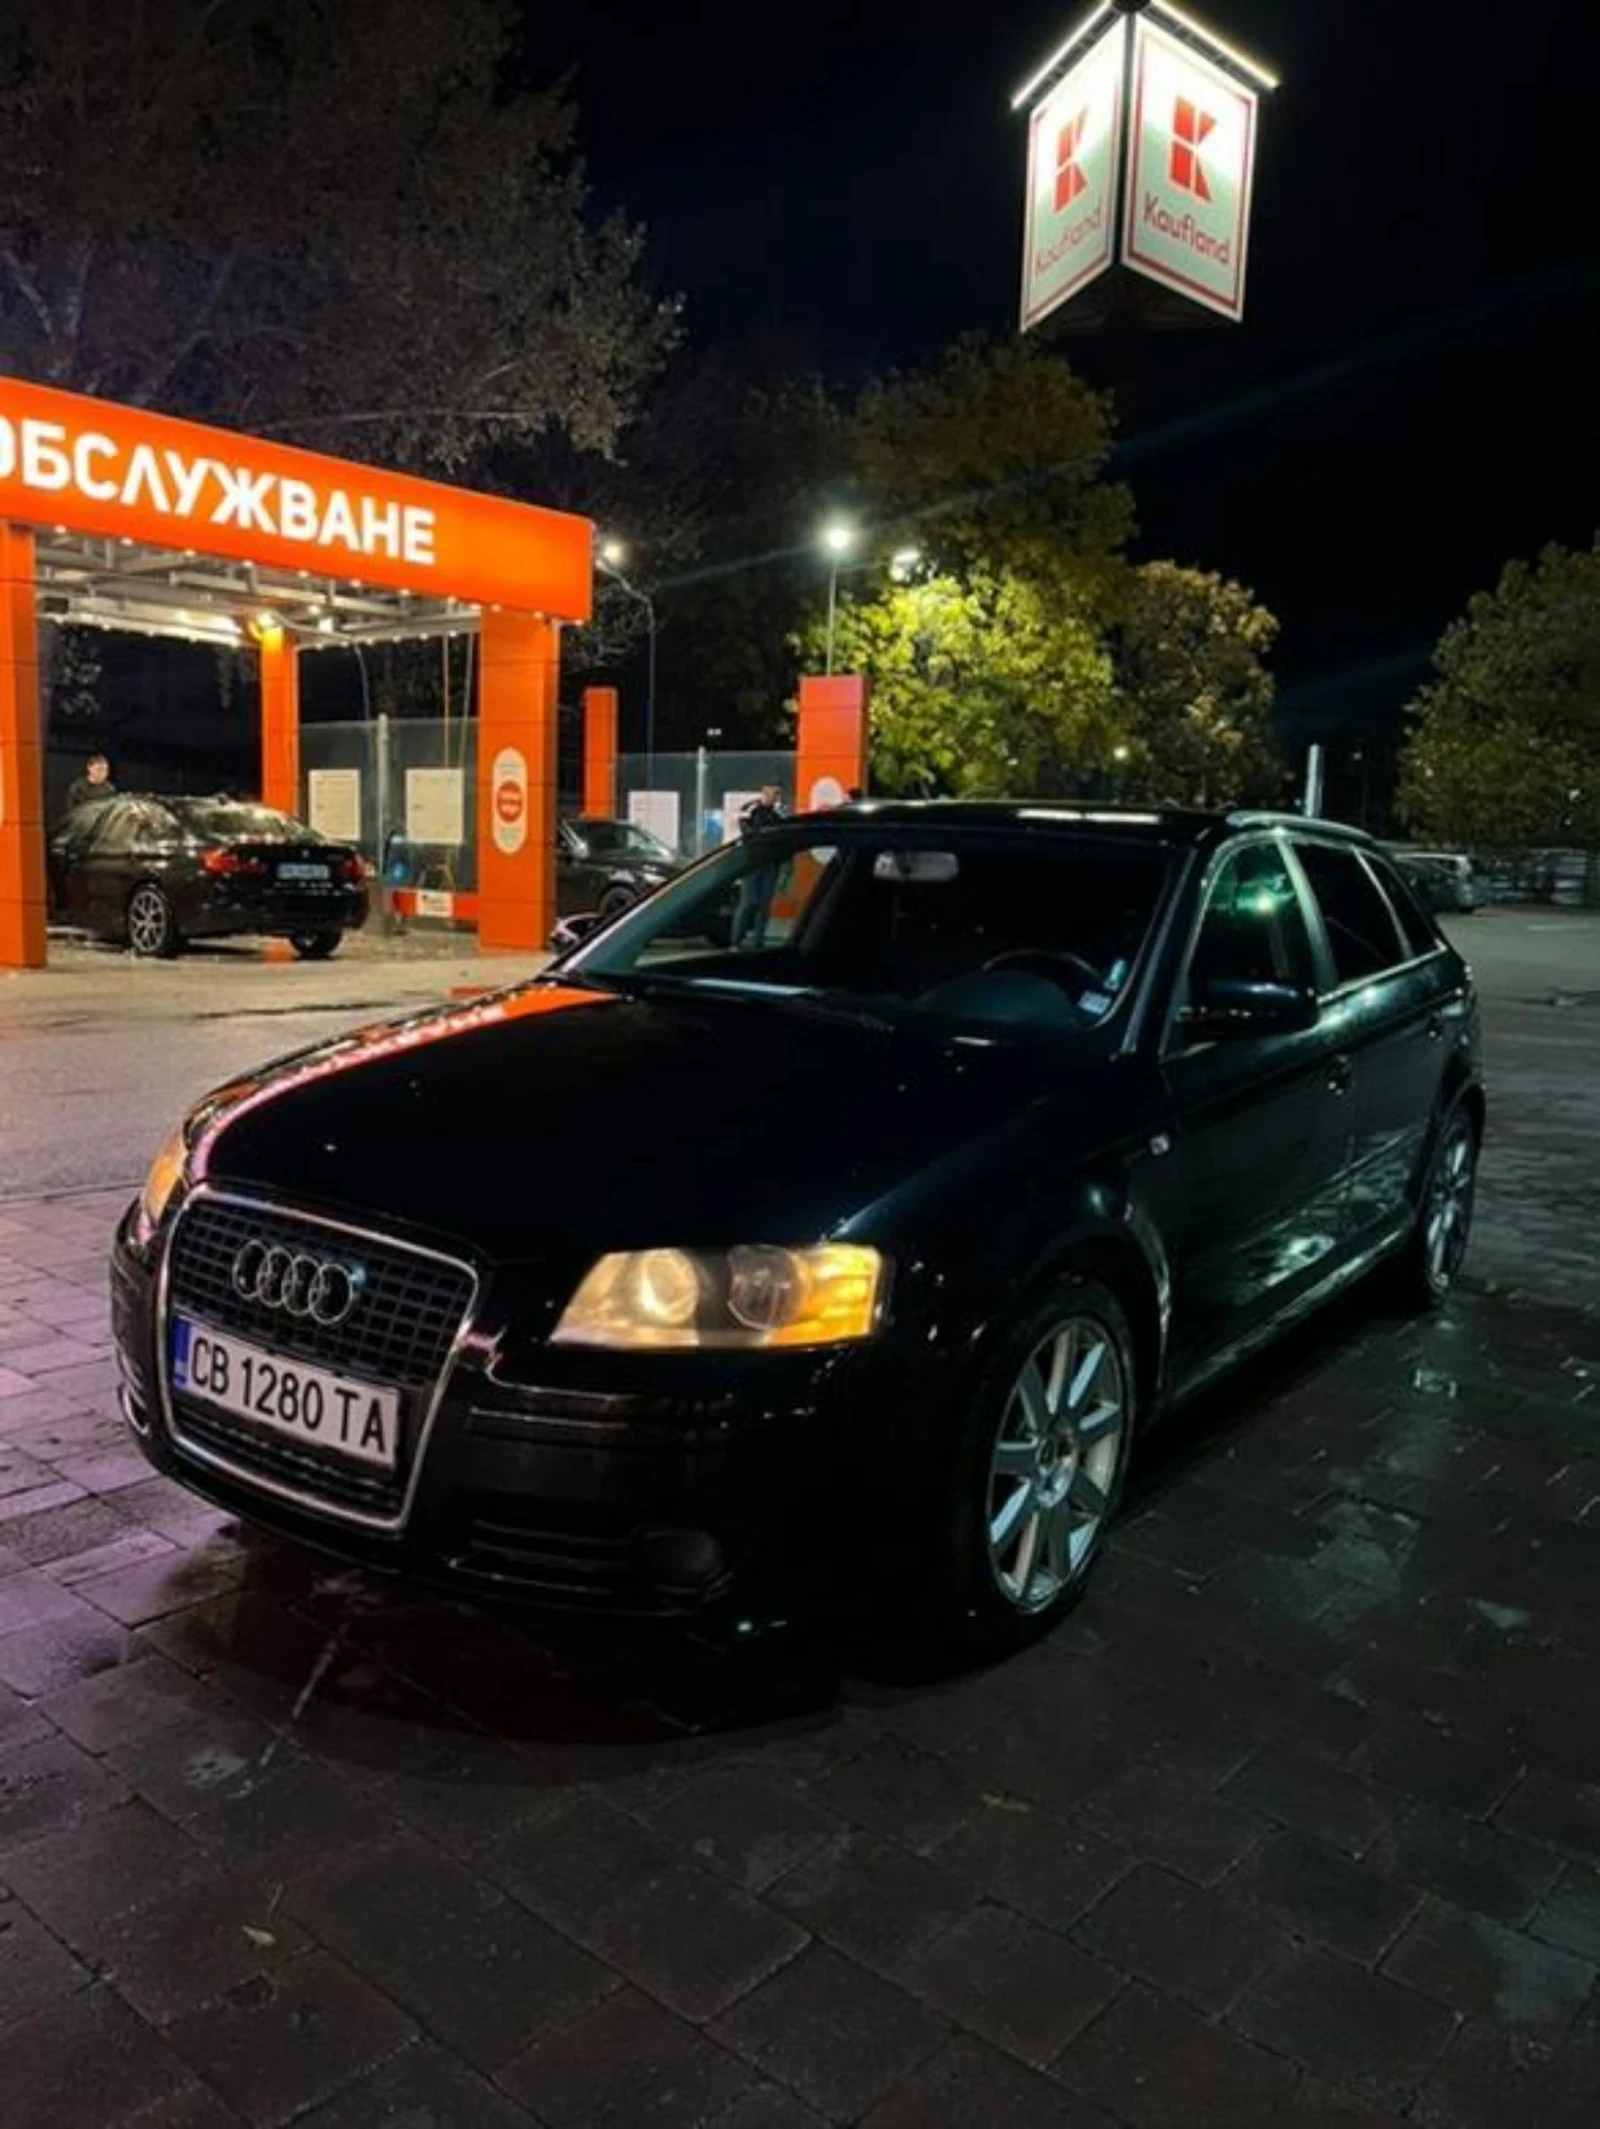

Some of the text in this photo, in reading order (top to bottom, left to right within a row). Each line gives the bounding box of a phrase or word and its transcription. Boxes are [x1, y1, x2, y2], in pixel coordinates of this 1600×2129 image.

[1143, 190, 1230, 266] Kaufland
[191, 1336, 386, 1453] CB 1280 TA
